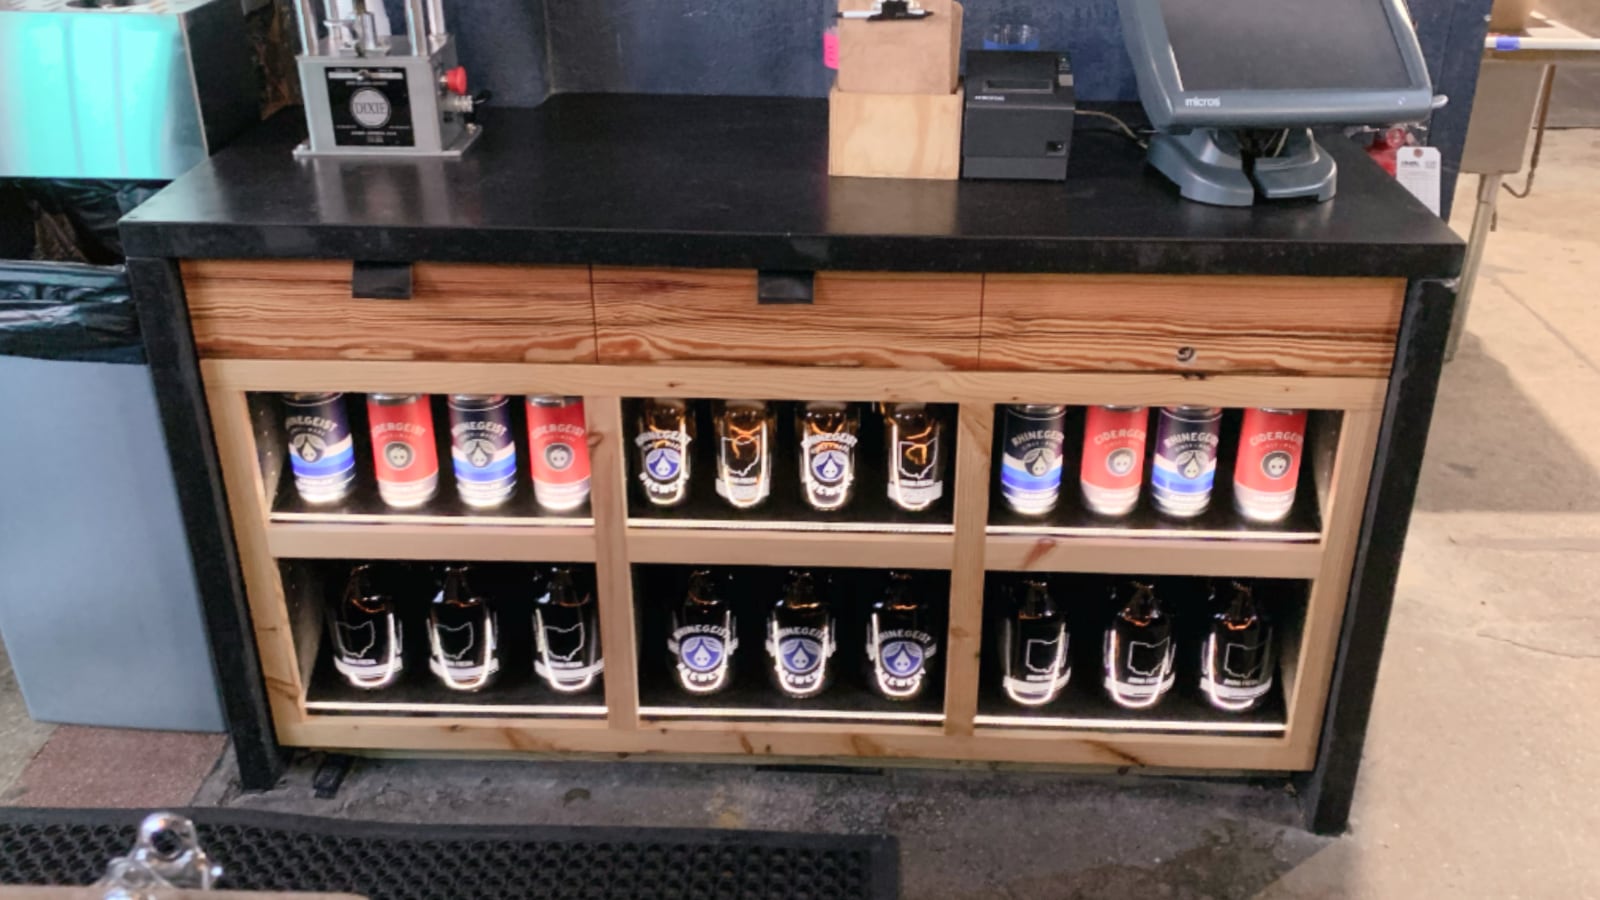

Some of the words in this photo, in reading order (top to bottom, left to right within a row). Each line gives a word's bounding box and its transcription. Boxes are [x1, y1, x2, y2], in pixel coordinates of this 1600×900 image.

[354, 102, 388, 115] DIXIE
[1185, 96, 1221, 107] micros
[775, 626, 829, 642] INEGEIST
[876, 629, 932, 645] HINEGEIST
